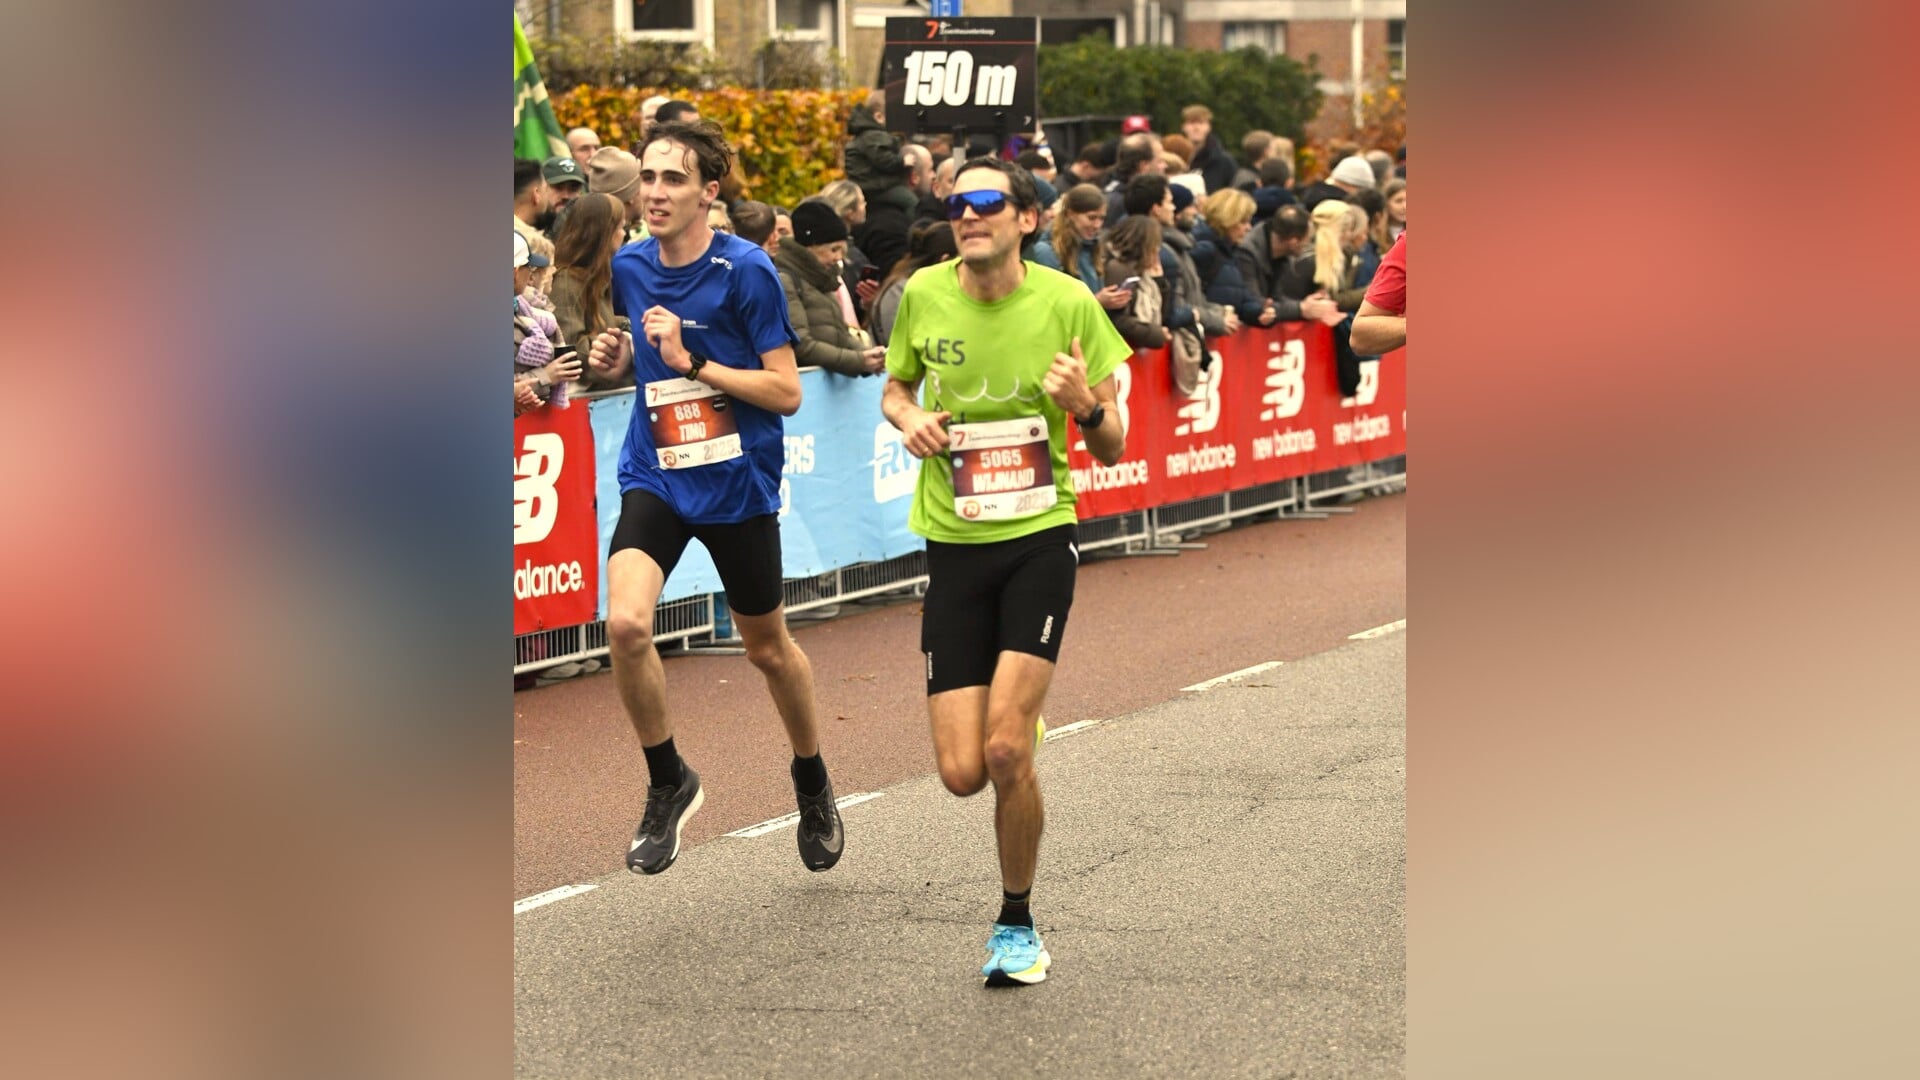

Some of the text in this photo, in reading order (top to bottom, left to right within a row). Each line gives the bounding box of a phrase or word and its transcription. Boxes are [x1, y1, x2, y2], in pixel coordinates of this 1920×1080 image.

[903, 50, 1017, 106] 150 m
[674, 402, 701, 421] 888
[679, 422, 706, 442] TIMO
[1252, 426, 1316, 461] new balance
[1333, 422, 1354, 445] new
[980, 449, 1022, 469] 5065
[1166, 442, 1236, 478] new balance
[972, 467, 1035, 493] WIJNAND
[1091, 459, 1148, 491] balance
[514, 559, 582, 600] alance
